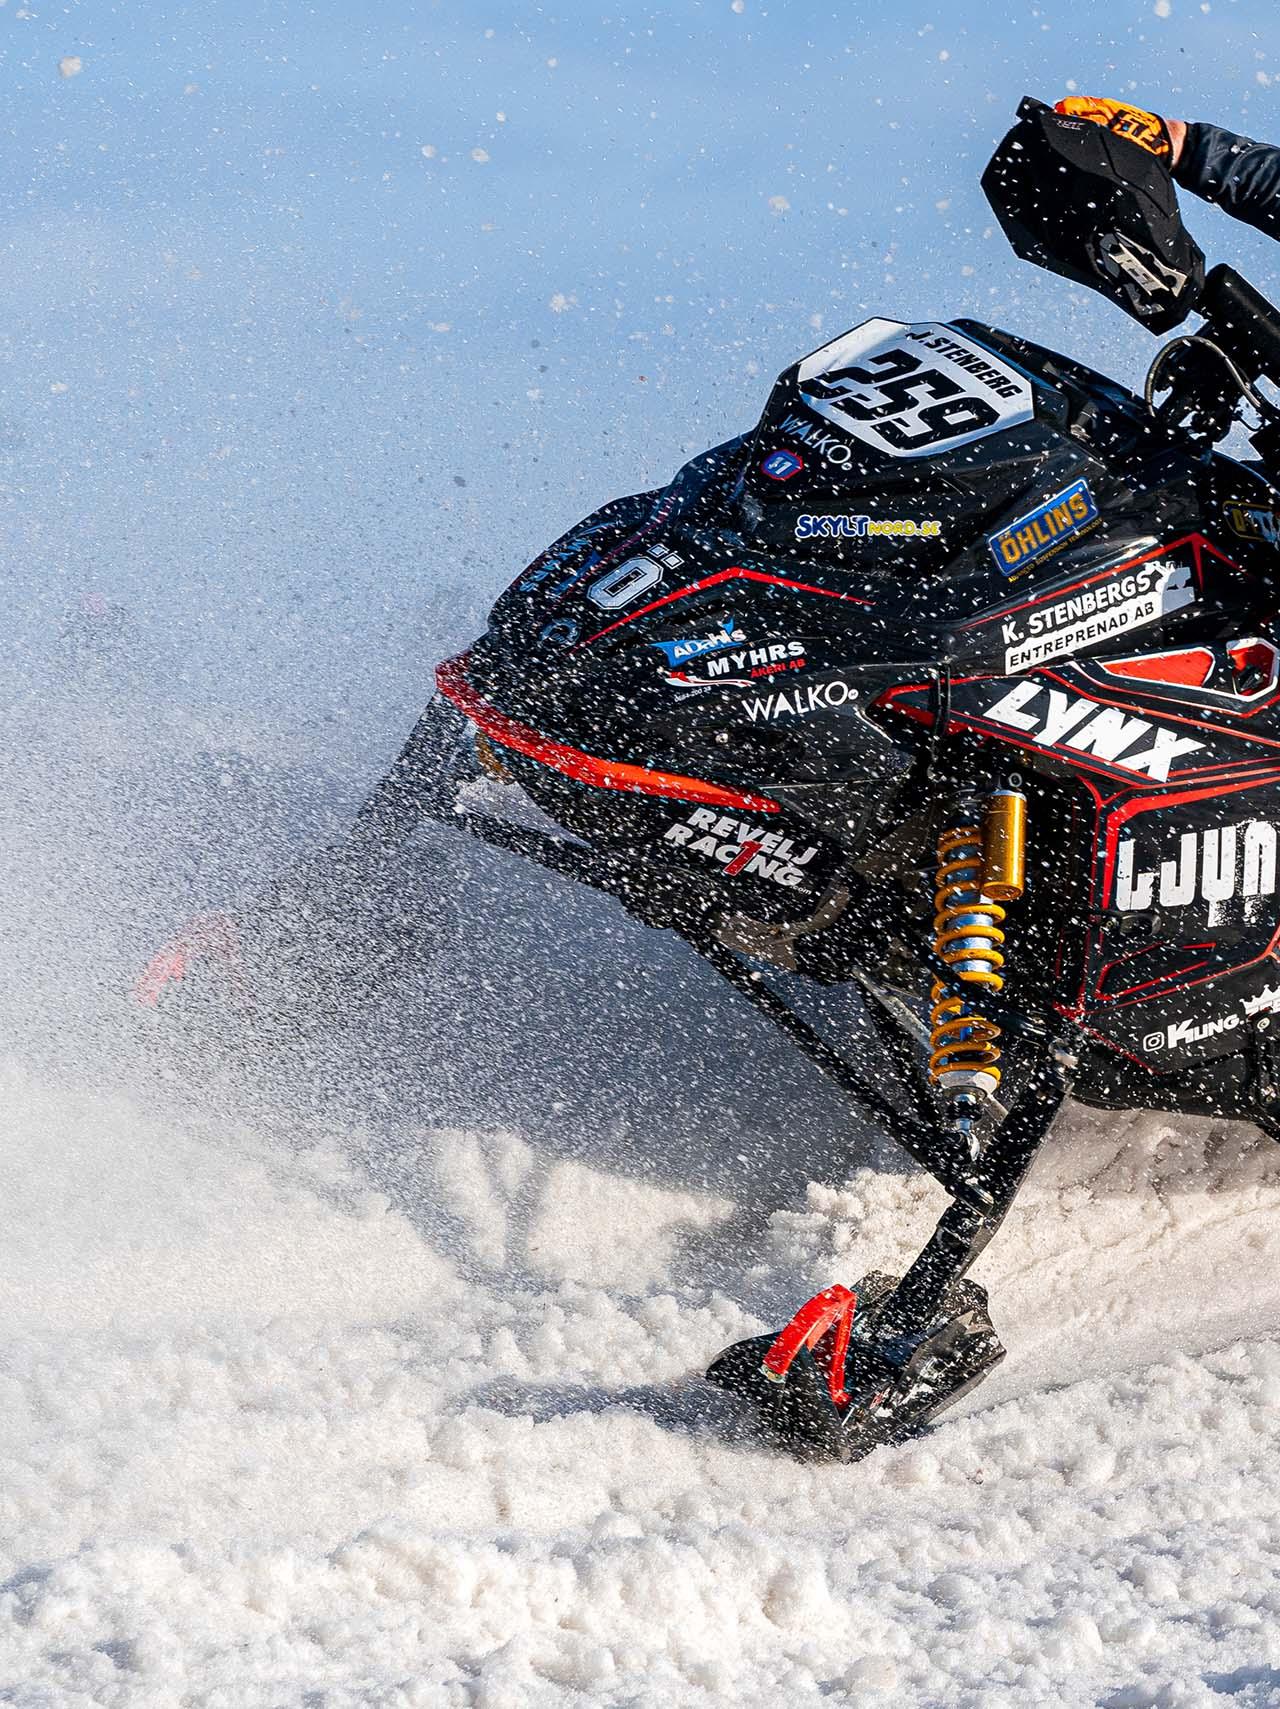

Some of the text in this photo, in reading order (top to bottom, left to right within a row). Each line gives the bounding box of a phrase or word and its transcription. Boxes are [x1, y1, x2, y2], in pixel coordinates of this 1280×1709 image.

[799, 348, 1001, 451] 259
[779, 414, 852, 464] WALKO
[998, 491, 1088, 564] ÖHLINS
[1002, 571, 1151, 645] K. STENBERGS
[1009, 601, 1155, 668] ENTREPRENAD AB
[707, 641, 805, 677] MYHRS
[789, 658, 806, 670] AB
[741, 680, 849, 722] WALKO
[982, 680, 1205, 782] LYNX
[686, 807, 819, 866] REVELJ
